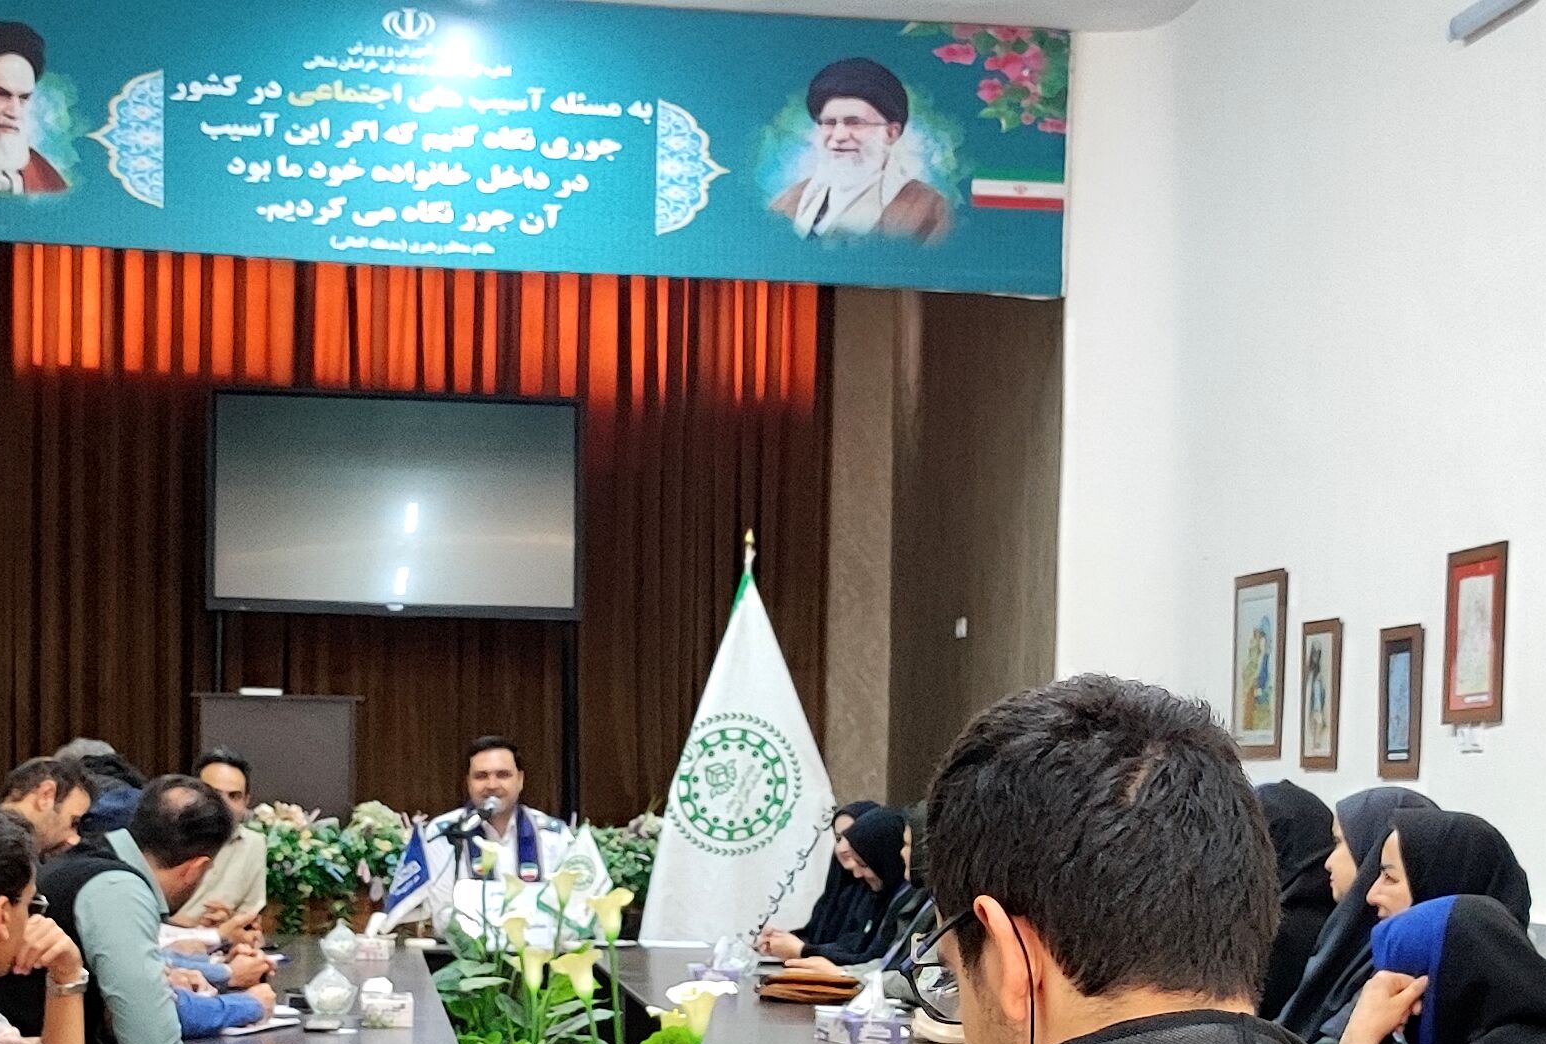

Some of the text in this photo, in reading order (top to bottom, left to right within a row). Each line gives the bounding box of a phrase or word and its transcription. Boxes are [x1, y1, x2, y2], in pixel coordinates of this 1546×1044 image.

[169, 73, 242, 102] کشور
[246, 80, 283, 105] در
[287, 79, 403, 110] اجتماعی
[467, 86, 546, 116] آسیب
[550, 91, 623, 118] مسئله
[626, 100, 654, 125] به
[199, 112, 623, 162] جوری نگاه کنیم که اگر این آسیب
[226, 154, 590, 199] در داخل خانواده خود ما بود
[351, 206, 397, 228] می
[401, 200, 455, 225] نگاه
[459, 208, 515, 233] جور
[519, 203, 563, 236] آن
